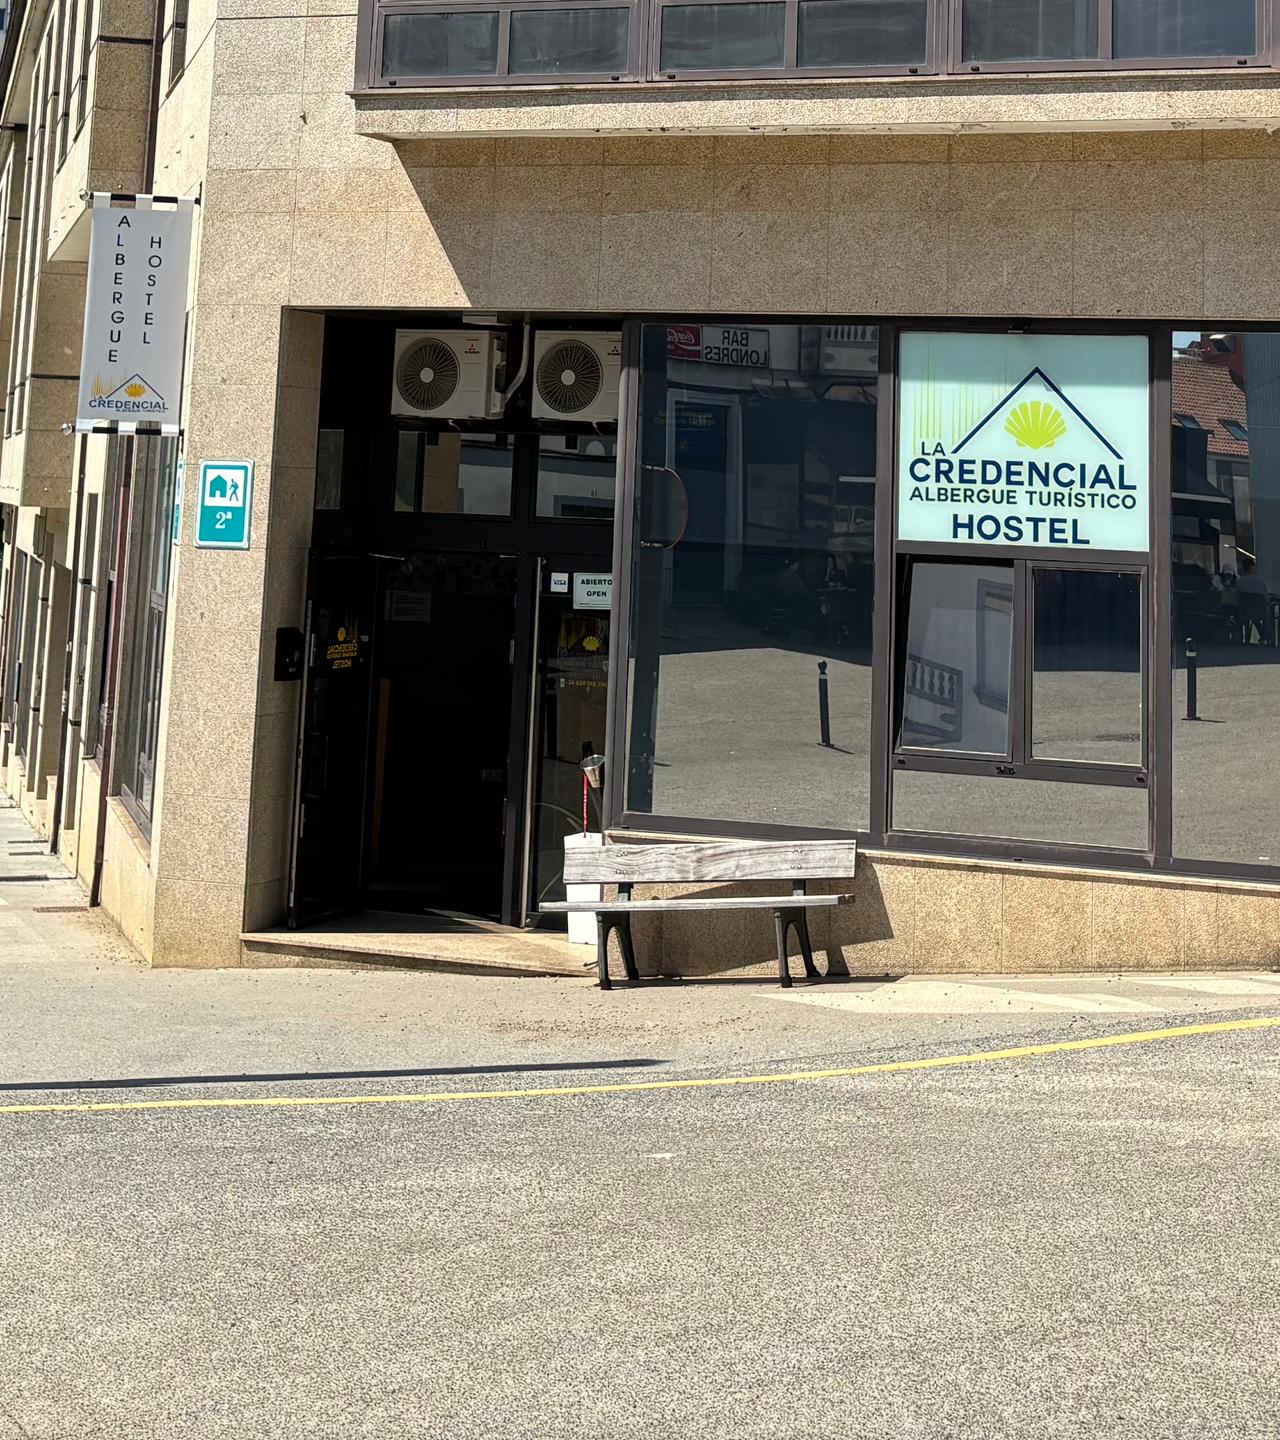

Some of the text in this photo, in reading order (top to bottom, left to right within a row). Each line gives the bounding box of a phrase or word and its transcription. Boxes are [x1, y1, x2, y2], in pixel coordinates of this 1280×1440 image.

[108, 214, 131, 363] ALBERGUE
[142, 236, 162, 345] HOSTEL
[89, 399, 169, 410] CREDENCIAL
[921, 441, 946, 456] LA
[909, 458, 1137, 490] CREDENCIAL
[910, 486, 1137, 510] ALBERGUE TURÍSTICO
[952, 513, 1090, 545] HOSTEL
[580, 578, 613, 586] ABIERTO
